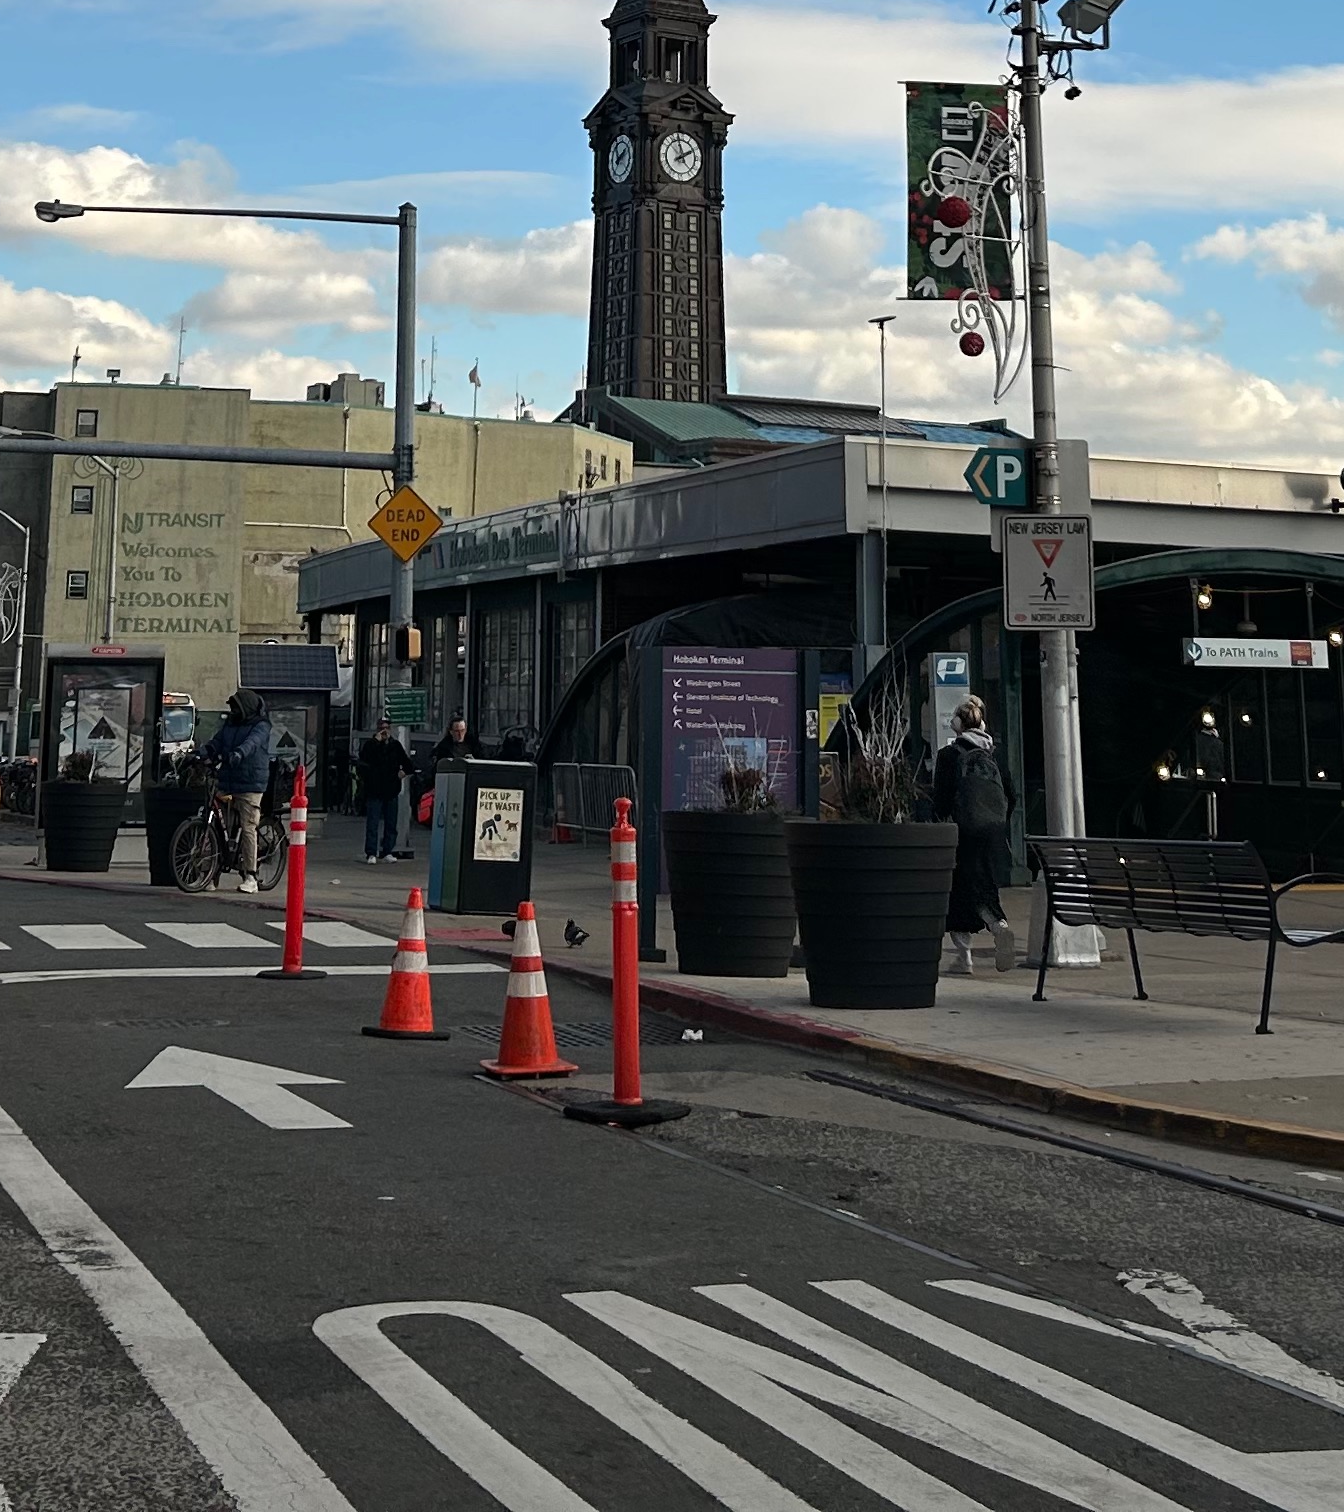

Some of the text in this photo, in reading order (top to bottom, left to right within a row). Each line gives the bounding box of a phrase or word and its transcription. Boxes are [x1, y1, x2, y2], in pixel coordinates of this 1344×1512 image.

[996, 455, 1022, 499] P
[386, 509, 425, 522] DEAD
[121, 512, 225, 534] NJ TRANSIT
[1009, 522, 1086, 535] NEW JERSEY LAW
[392, 529, 420, 542] END
[121, 542, 218, 558] Welcomes
[120, 566, 182, 582] You To
[118, 591, 229, 607] HOBOKEN
[1031, 613, 1056, 623] NORTH
[1057, 613, 1086, 623] JERSEY
[117, 617, 238, 633] TERMINAL
[673, 654, 744, 665] Hoboken Terminal
[1205, 648, 1279, 658] To PATH Trains
[479, 791, 511, 801] PICK UP
[479, 802, 520, 811] PET WASTE
